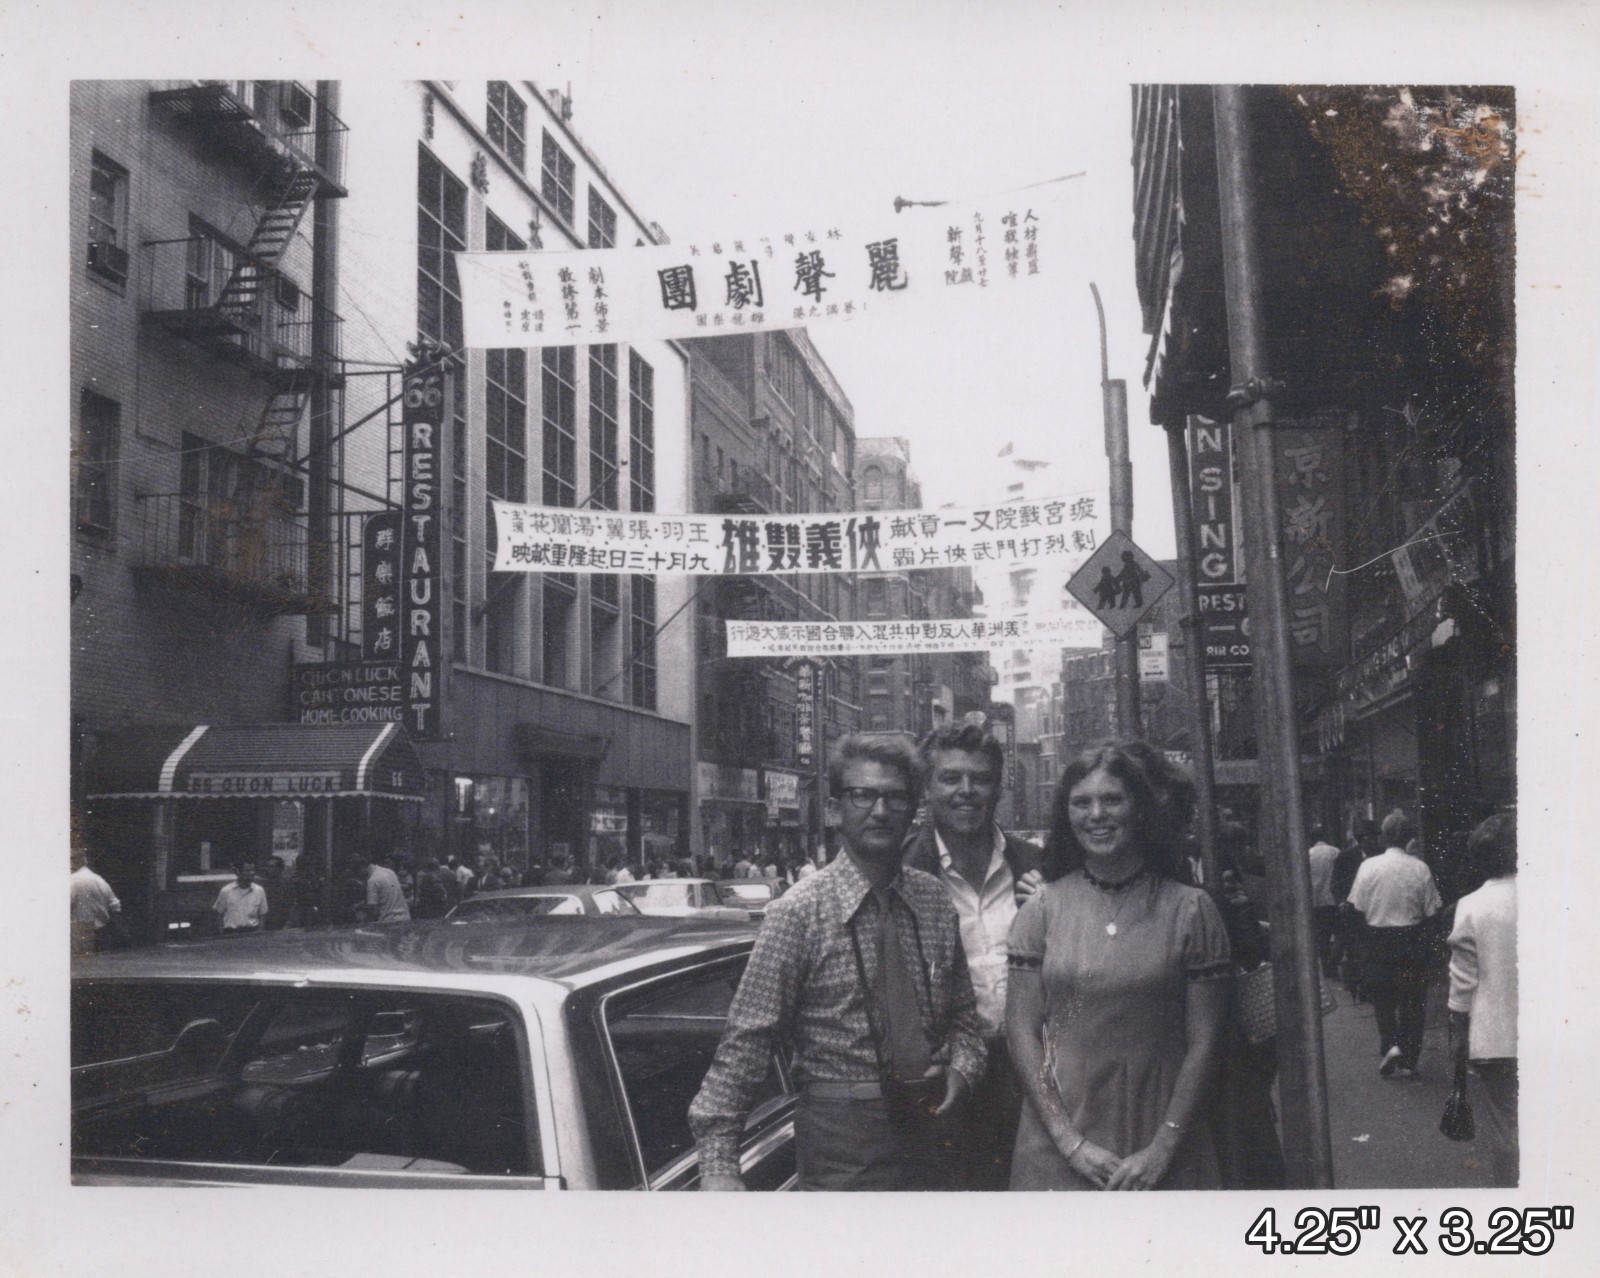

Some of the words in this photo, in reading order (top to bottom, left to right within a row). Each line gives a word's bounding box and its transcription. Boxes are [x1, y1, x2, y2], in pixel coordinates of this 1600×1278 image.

[657, 238, 908, 312] 麗聲劇團
[404, 376, 441, 408] 66
[410, 422, 433, 731] RESTAURANT
[1139, 636, 1151, 649] NO
[341, 705, 404, 723] COOKING
[222, 778, 273, 792] QUON
[288, 777, 334, 792] LUCK
